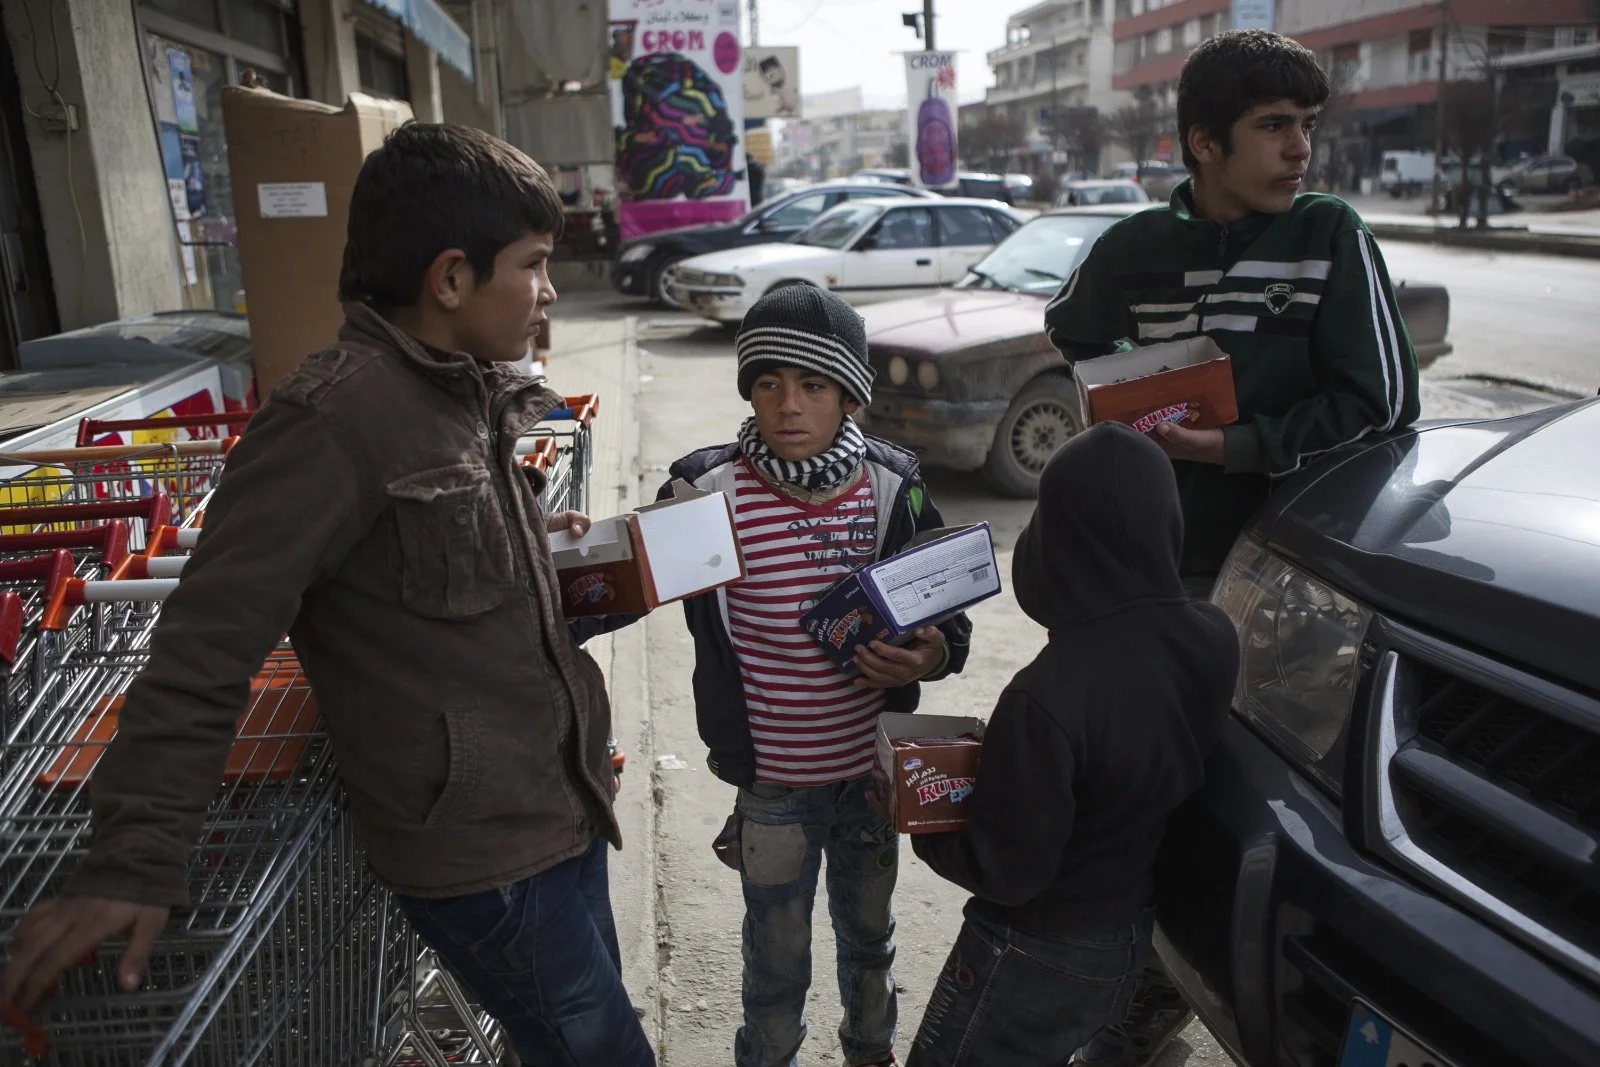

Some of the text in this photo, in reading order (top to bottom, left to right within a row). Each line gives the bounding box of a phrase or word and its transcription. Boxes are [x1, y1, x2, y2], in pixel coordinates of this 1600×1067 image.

[642, 30, 705, 51] CROM
[911, 54, 952, 70] CROM
[1133, 402, 1188, 433] RUBY
